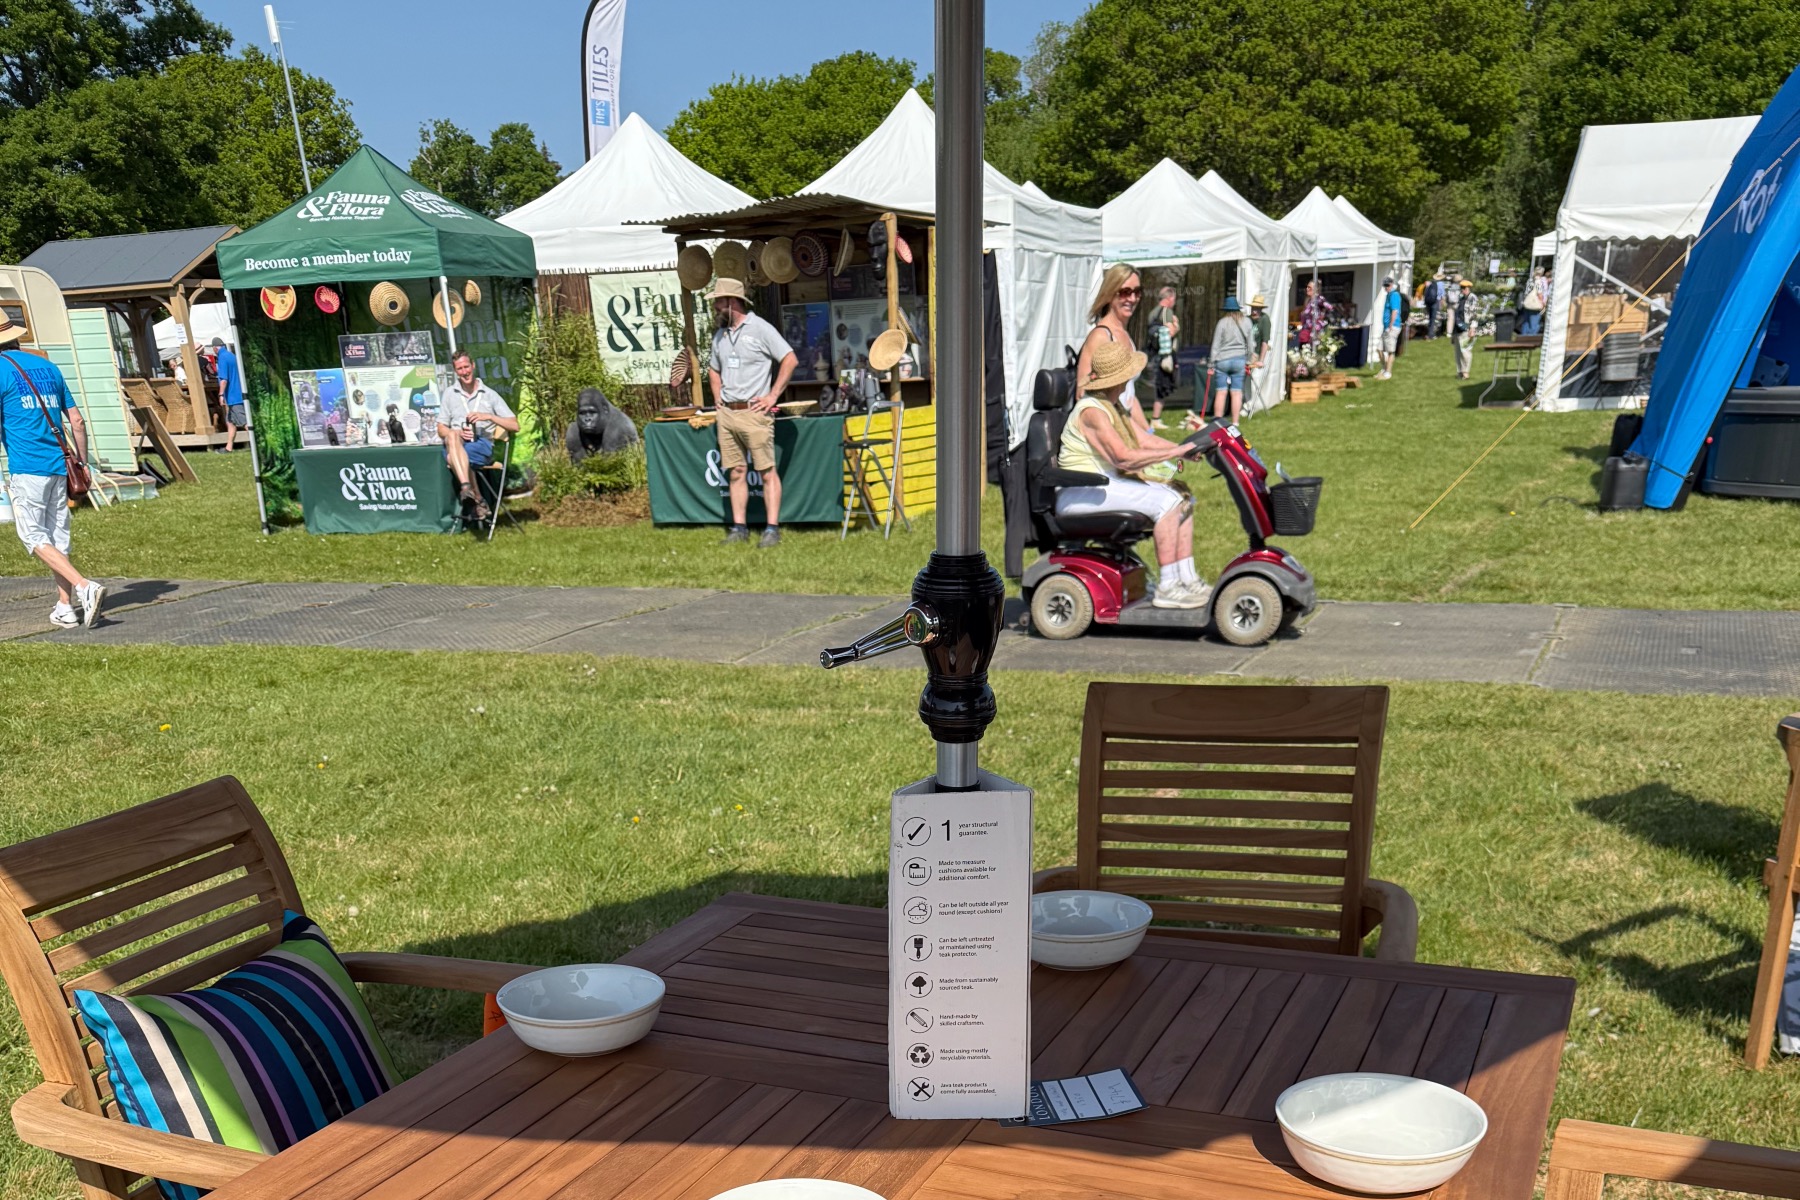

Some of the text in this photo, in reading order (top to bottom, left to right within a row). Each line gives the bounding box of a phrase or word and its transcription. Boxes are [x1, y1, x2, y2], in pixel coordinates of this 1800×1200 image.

[592, 44, 610, 125] TIM'S TILES
[296, 196, 385, 219] & Flora
[324, 190, 391, 205] Fauna
[244, 247, 412, 271] Become a member today
[606, 294, 646, 353] &
[20, 394, 35, 409] SO
[352, 462, 412, 482] Fauna
[339, 467, 416, 501] & Flora
[941, 819, 951, 842] 1
[958, 829, 989, 837] guarantee.
[938, 866, 963, 874] cushions
[1029, 1085, 1051, 1120] LONDON
